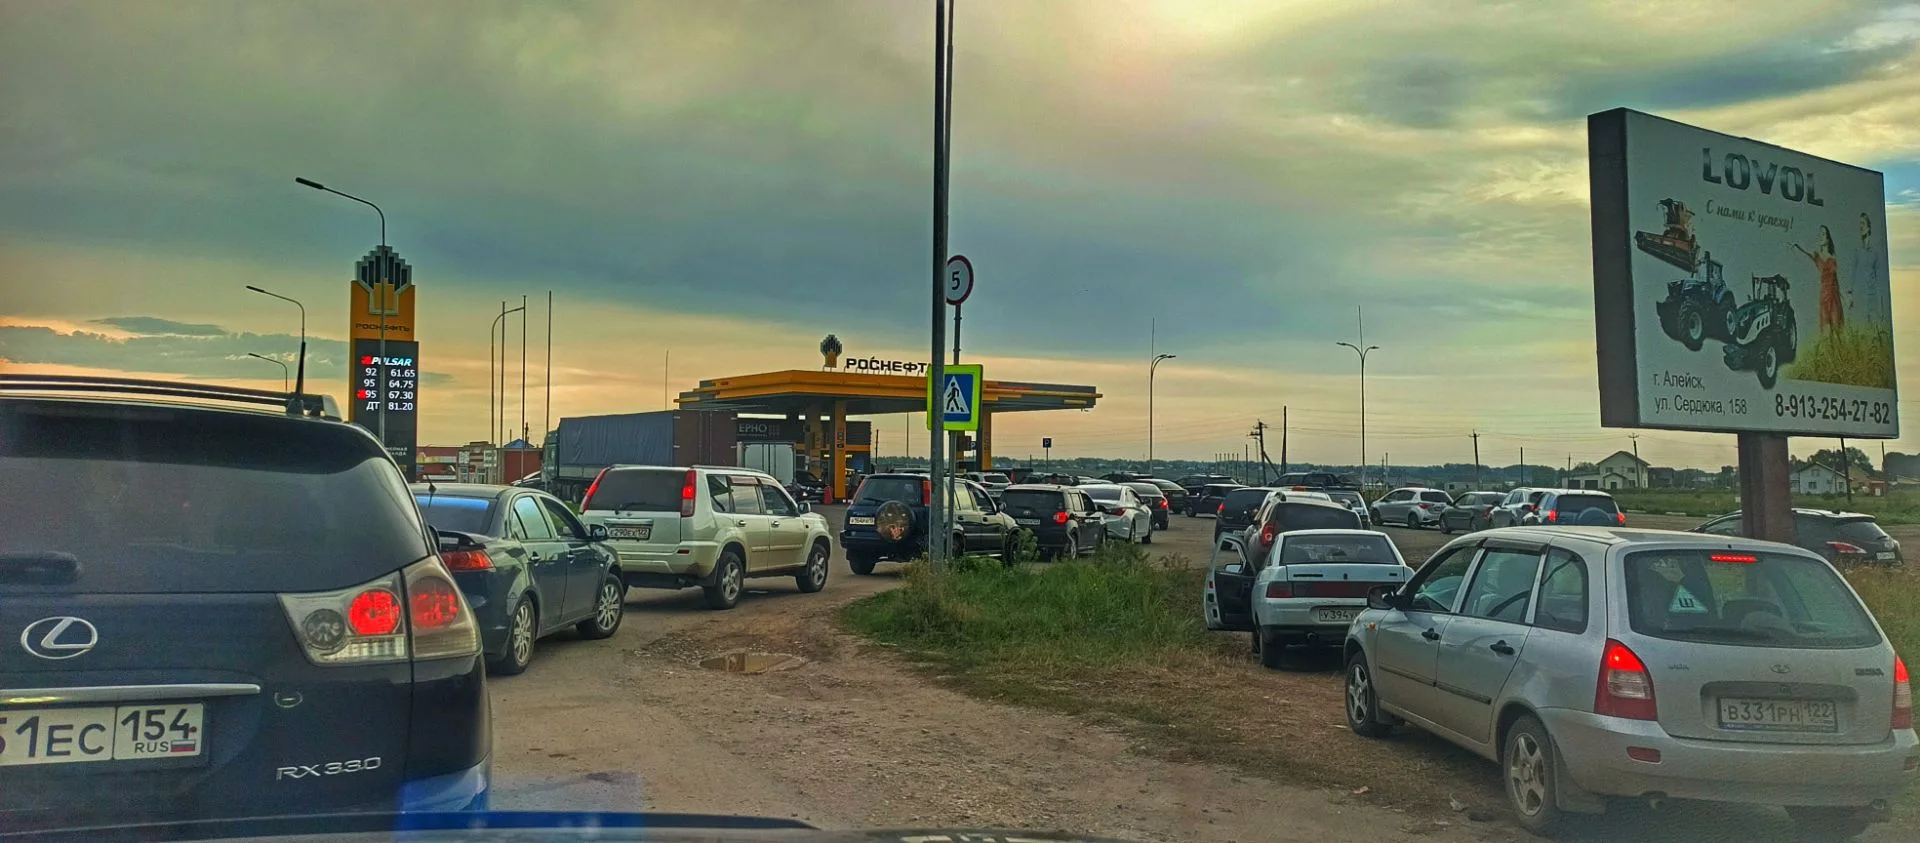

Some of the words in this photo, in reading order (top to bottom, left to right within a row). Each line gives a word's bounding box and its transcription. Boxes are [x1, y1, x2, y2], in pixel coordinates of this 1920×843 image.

[1703, 148, 1824, 207] LOVOL
[1706, 199, 1714, 215] С
[1717, 206, 1744, 221] нами
[1748, 211, 1756, 222] к
[1758, 213, 1794, 233] успеху!
[951, 270, 961, 291] 5
[365, 367, 378, 377] 92
[390, 368, 416, 378] 61.65
[846, 357, 929, 373] РОСНЕФТ
[363, 378, 376, 388] 95
[388, 379, 414, 389] 64.75
[1663, 370, 1706, 391] Алейск,
[365, 390, 378, 399] 95
[388, 390, 414, 400] 67.30
[1655, 396, 1671, 414] ул.
[1674, 394, 1726, 416] Сердюка,
[1729, 398, 1748, 415] 158
[366, 401, 381, 411] ДТ
[388, 401, 414, 411] 81.20
[1775, 393, 1890, 425] 8-913-254-27-82
[1679, 597, 1694, 608] Ш
[1727, 702, 1800, 722] В331РН
[1804, 702, 1832, 718] 122
[121, 708, 190, 742] 154
[134, 740, 169, 753] RUS
